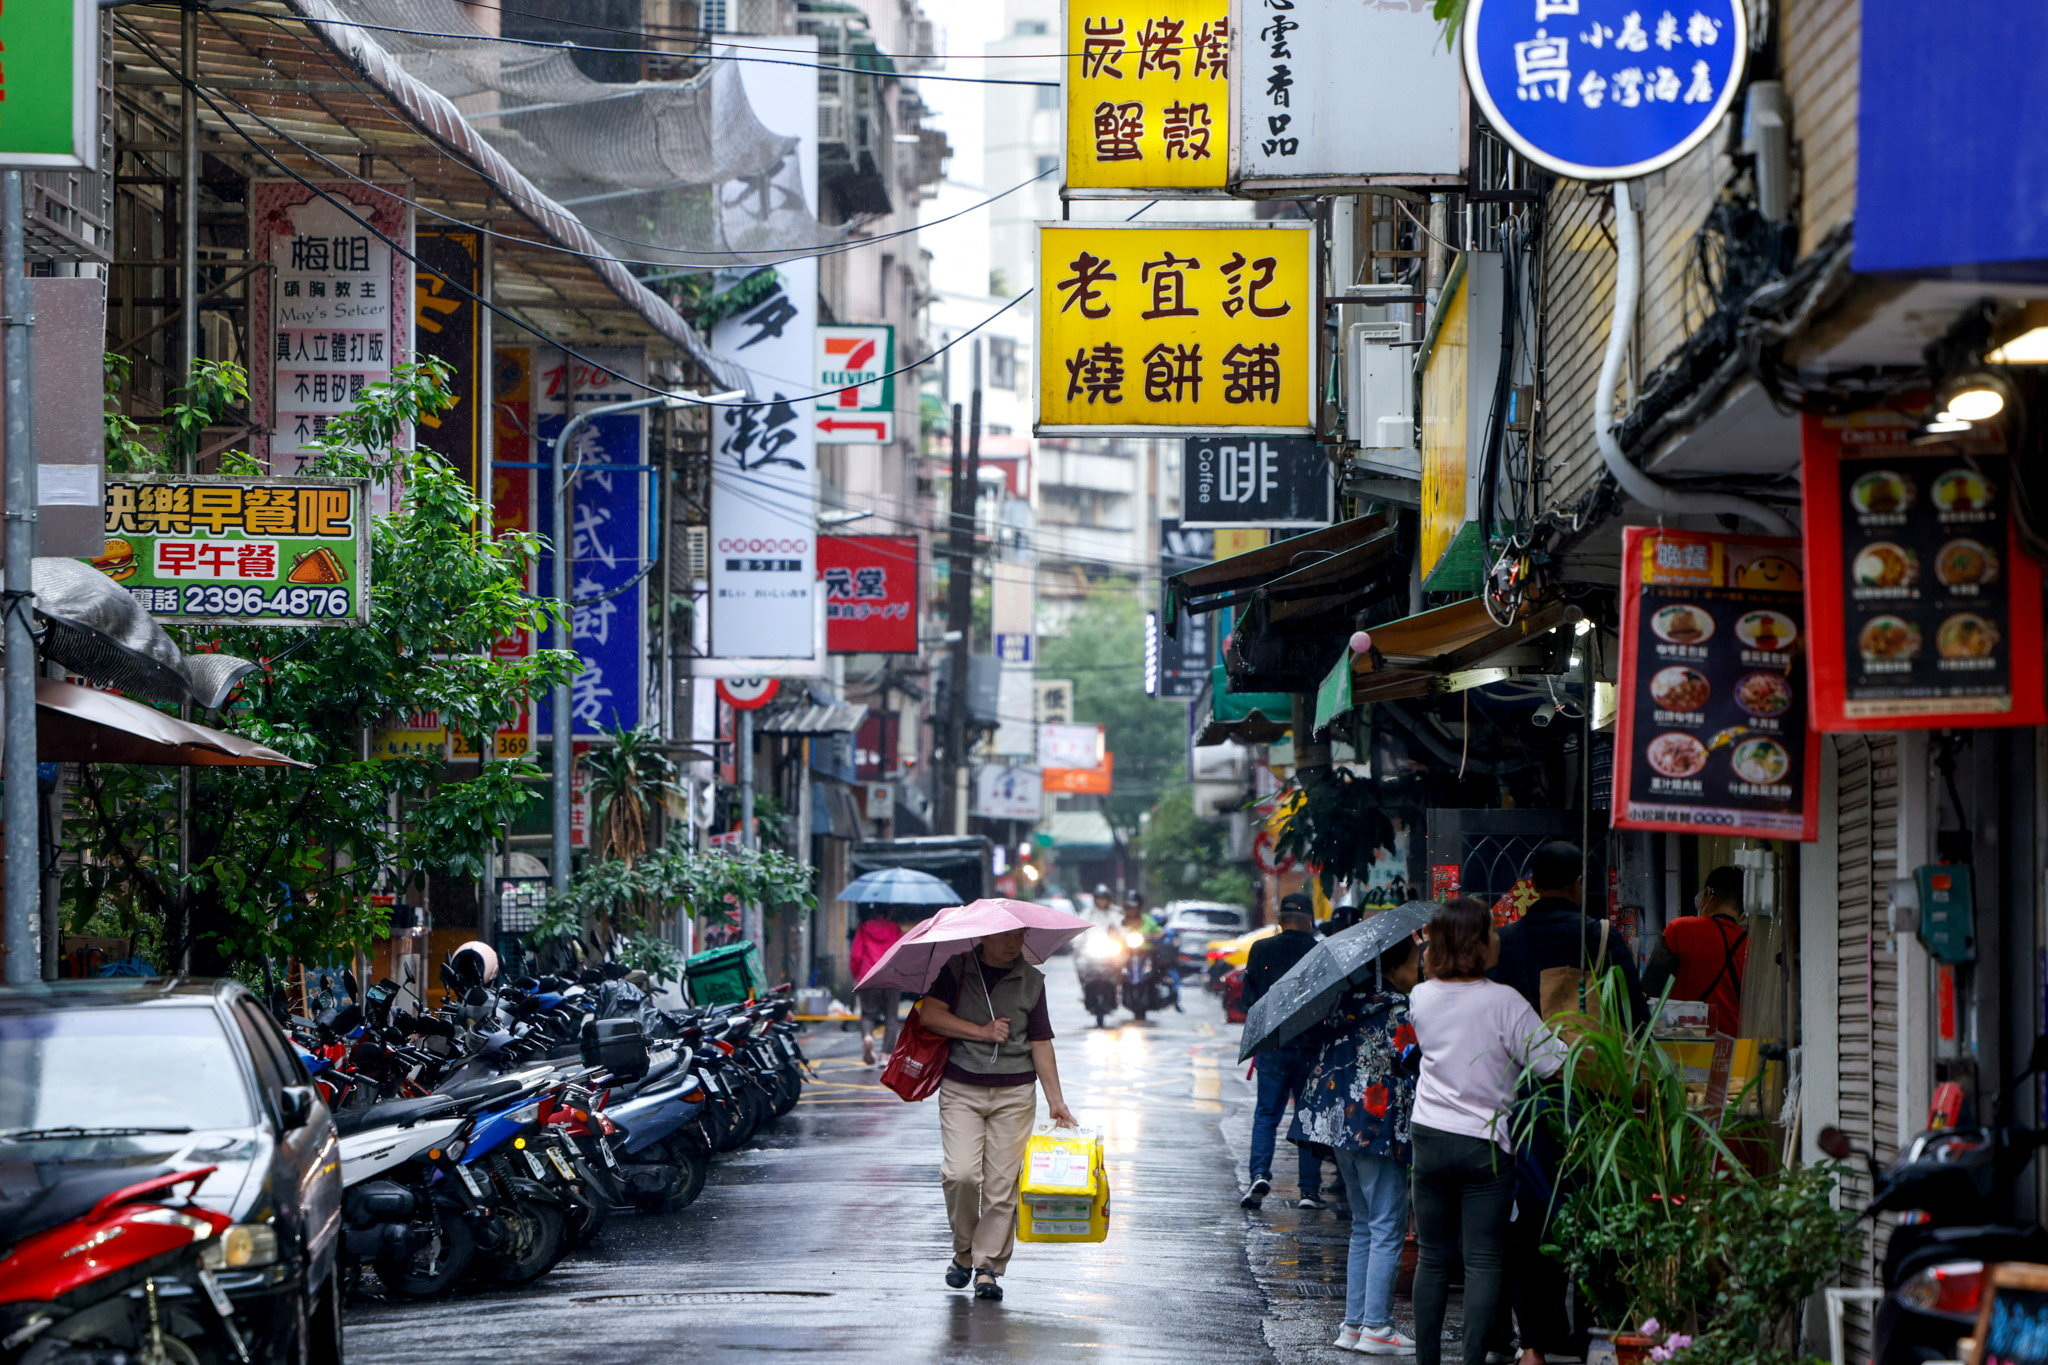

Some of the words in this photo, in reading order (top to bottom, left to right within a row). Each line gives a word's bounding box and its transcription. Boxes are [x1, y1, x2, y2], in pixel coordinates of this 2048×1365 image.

[1095, 101, 1211, 161] 蟹殼
[291, 235, 370, 272] 梅姐
[284, 281, 376, 298] 碩胸教主
[1056, 250, 1292, 320] 老宜記
[279, 306, 327, 324] May's
[277, 332, 384, 363] 真人立體打版
[294, 373, 366, 404] 不用矽膠
[824, 338, 875, 408] 7
[1198, 448, 1214, 504] Coffee
[1219, 441, 1279, 504] 啡
[104, 485, 350, 535] 快樂早餐吧
[157, 543, 275, 578] 早午餐
[184, 587, 348, 613] 2396-4876
[499, 737, 528, 754] 369
